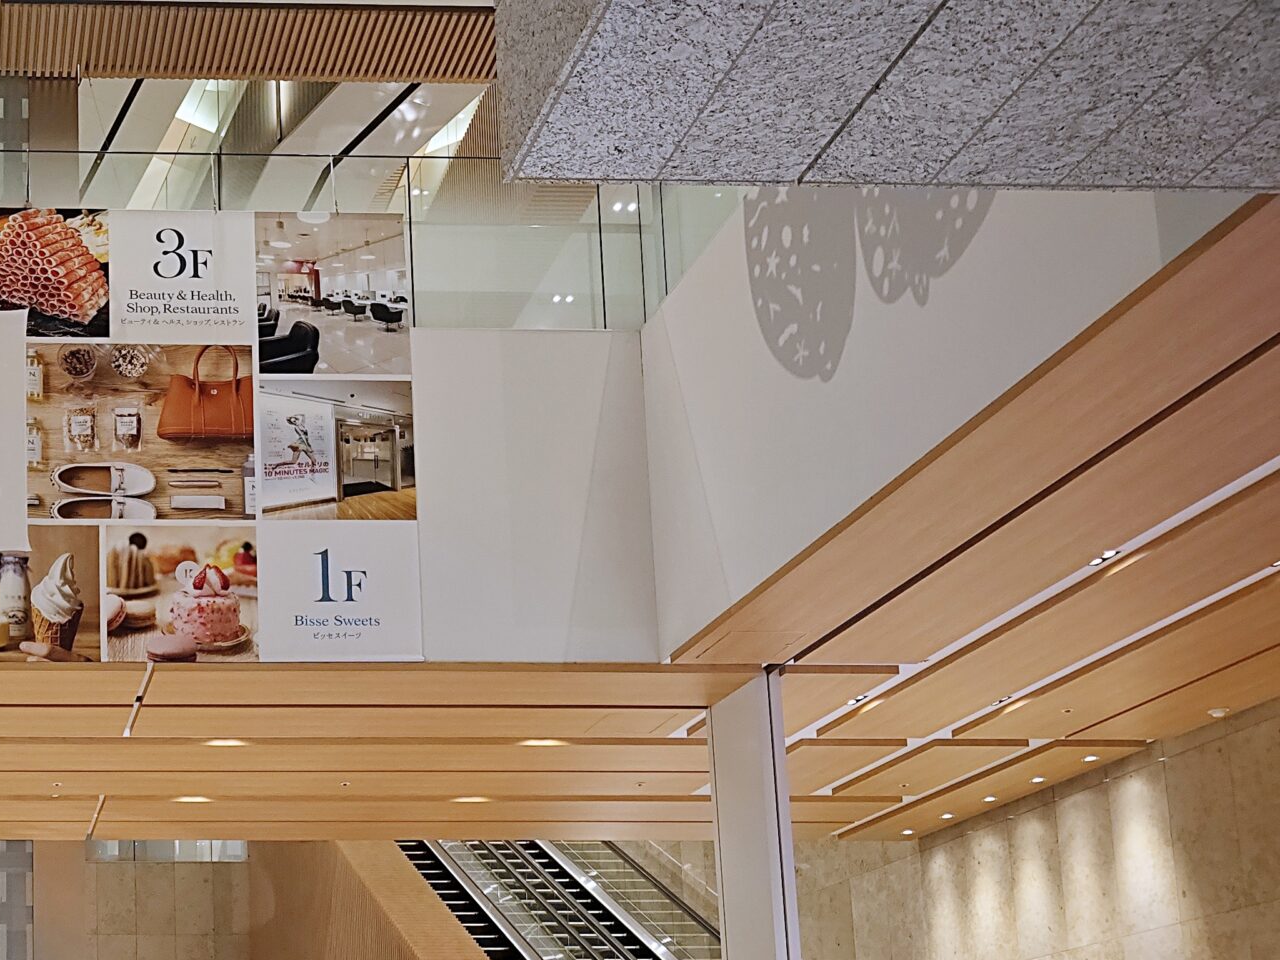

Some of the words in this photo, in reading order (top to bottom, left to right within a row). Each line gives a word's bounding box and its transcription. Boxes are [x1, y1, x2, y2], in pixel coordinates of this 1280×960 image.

[153, 228, 213, 279] 3F
[129, 290, 174, 303] Beauty
[176, 290, 187, 301] &
[190, 290, 236, 302] Health,
[126, 302, 161, 315] Shop,
[163, 303, 239, 315] Restaurants
[264, 470, 273, 478] 10
[274, 468, 308, 477] MINUTES
[309, 467, 329, 475] MAGIC
[313, 548, 367, 602] 1F
[294, 615, 329, 627] Bisse
[334, 615, 380, 627] Sweets
[313, 632, 361, 640] ビッセスイーツ
